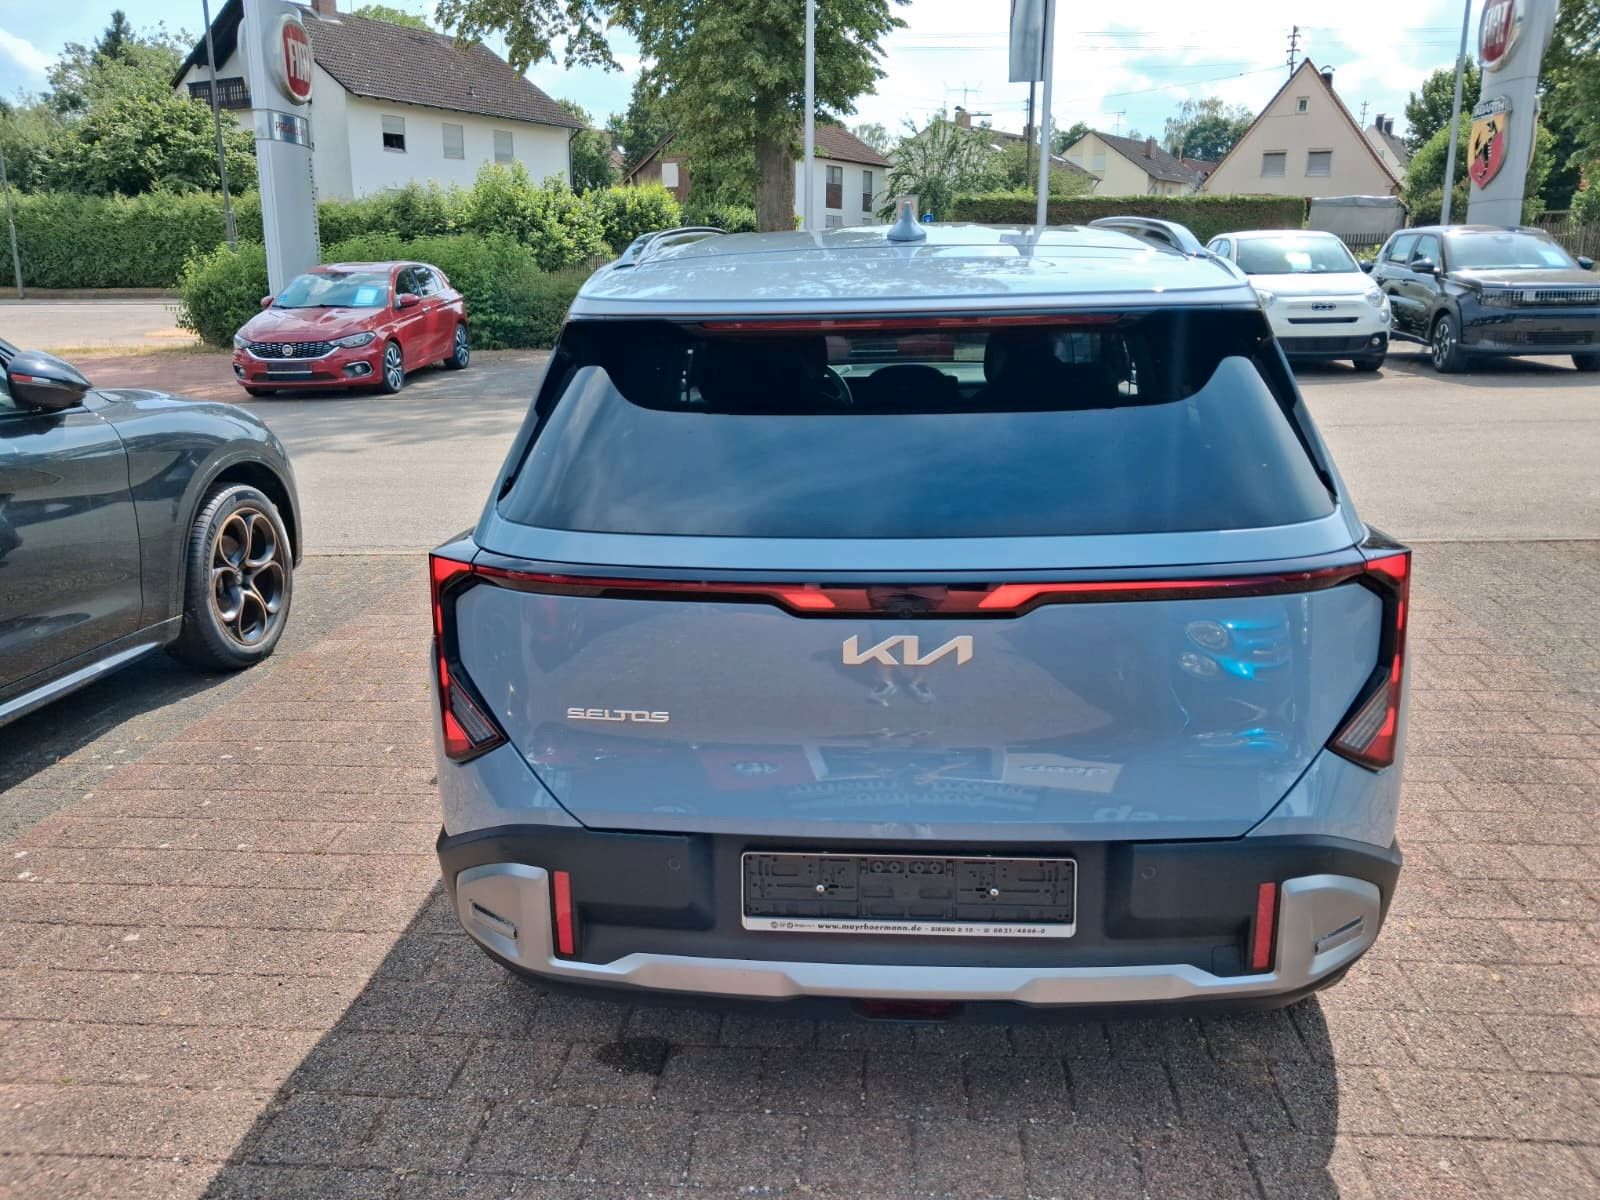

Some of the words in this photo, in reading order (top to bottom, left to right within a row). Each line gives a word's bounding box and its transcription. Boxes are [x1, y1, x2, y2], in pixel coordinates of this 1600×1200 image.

[843, 634, 973, 665] KIA
[566, 706, 670, 724] SELTOS
[817, 922, 922, 933] www.mayrhoermann.de
